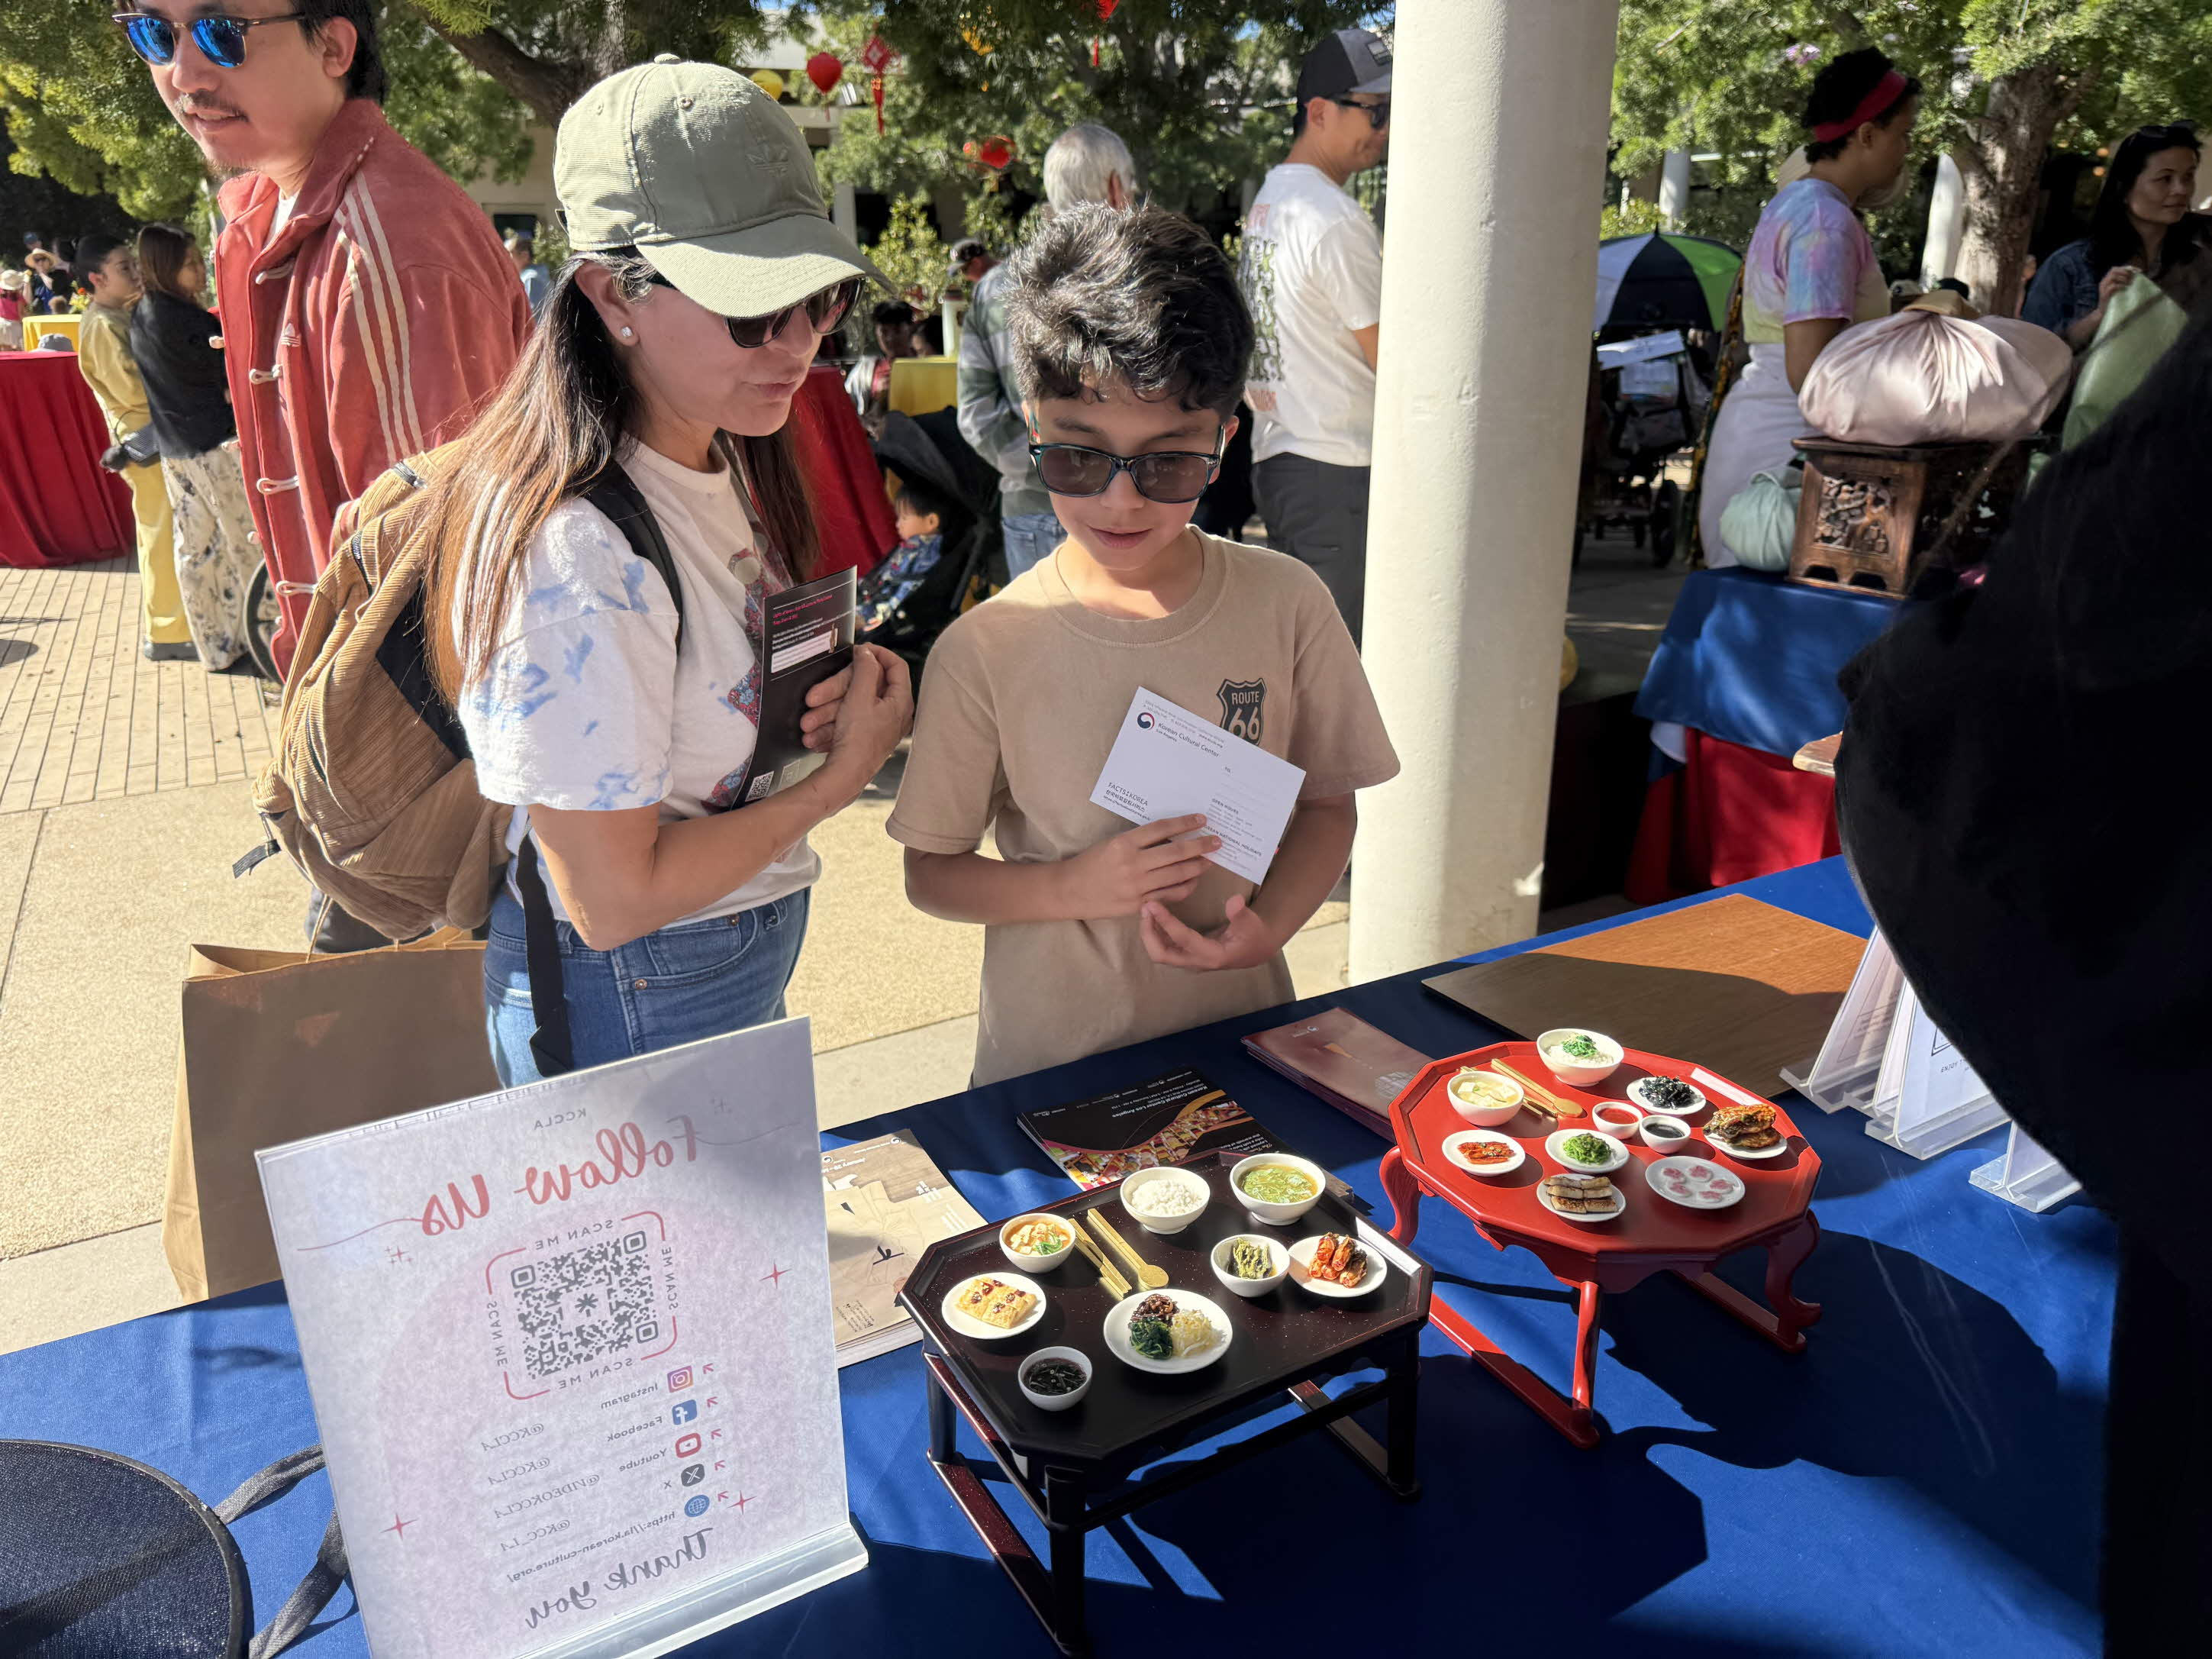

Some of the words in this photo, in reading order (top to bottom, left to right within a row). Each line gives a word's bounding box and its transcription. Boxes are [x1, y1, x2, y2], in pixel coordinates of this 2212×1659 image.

[1231, 691, 1259, 705] ROUTE
[1228, 705, 1260, 740] 66
[1158, 723, 1178, 736] Korean
[1179, 733, 1201, 747] Cultural
[1201, 744, 1219, 757] Center
[1188, 1086, 1208, 1096] Korean
[1168, 1092, 1188, 1103] Cultural
[1147, 1099, 1166, 1109] Center
[1112, 1109, 1135, 1118] Angeles
